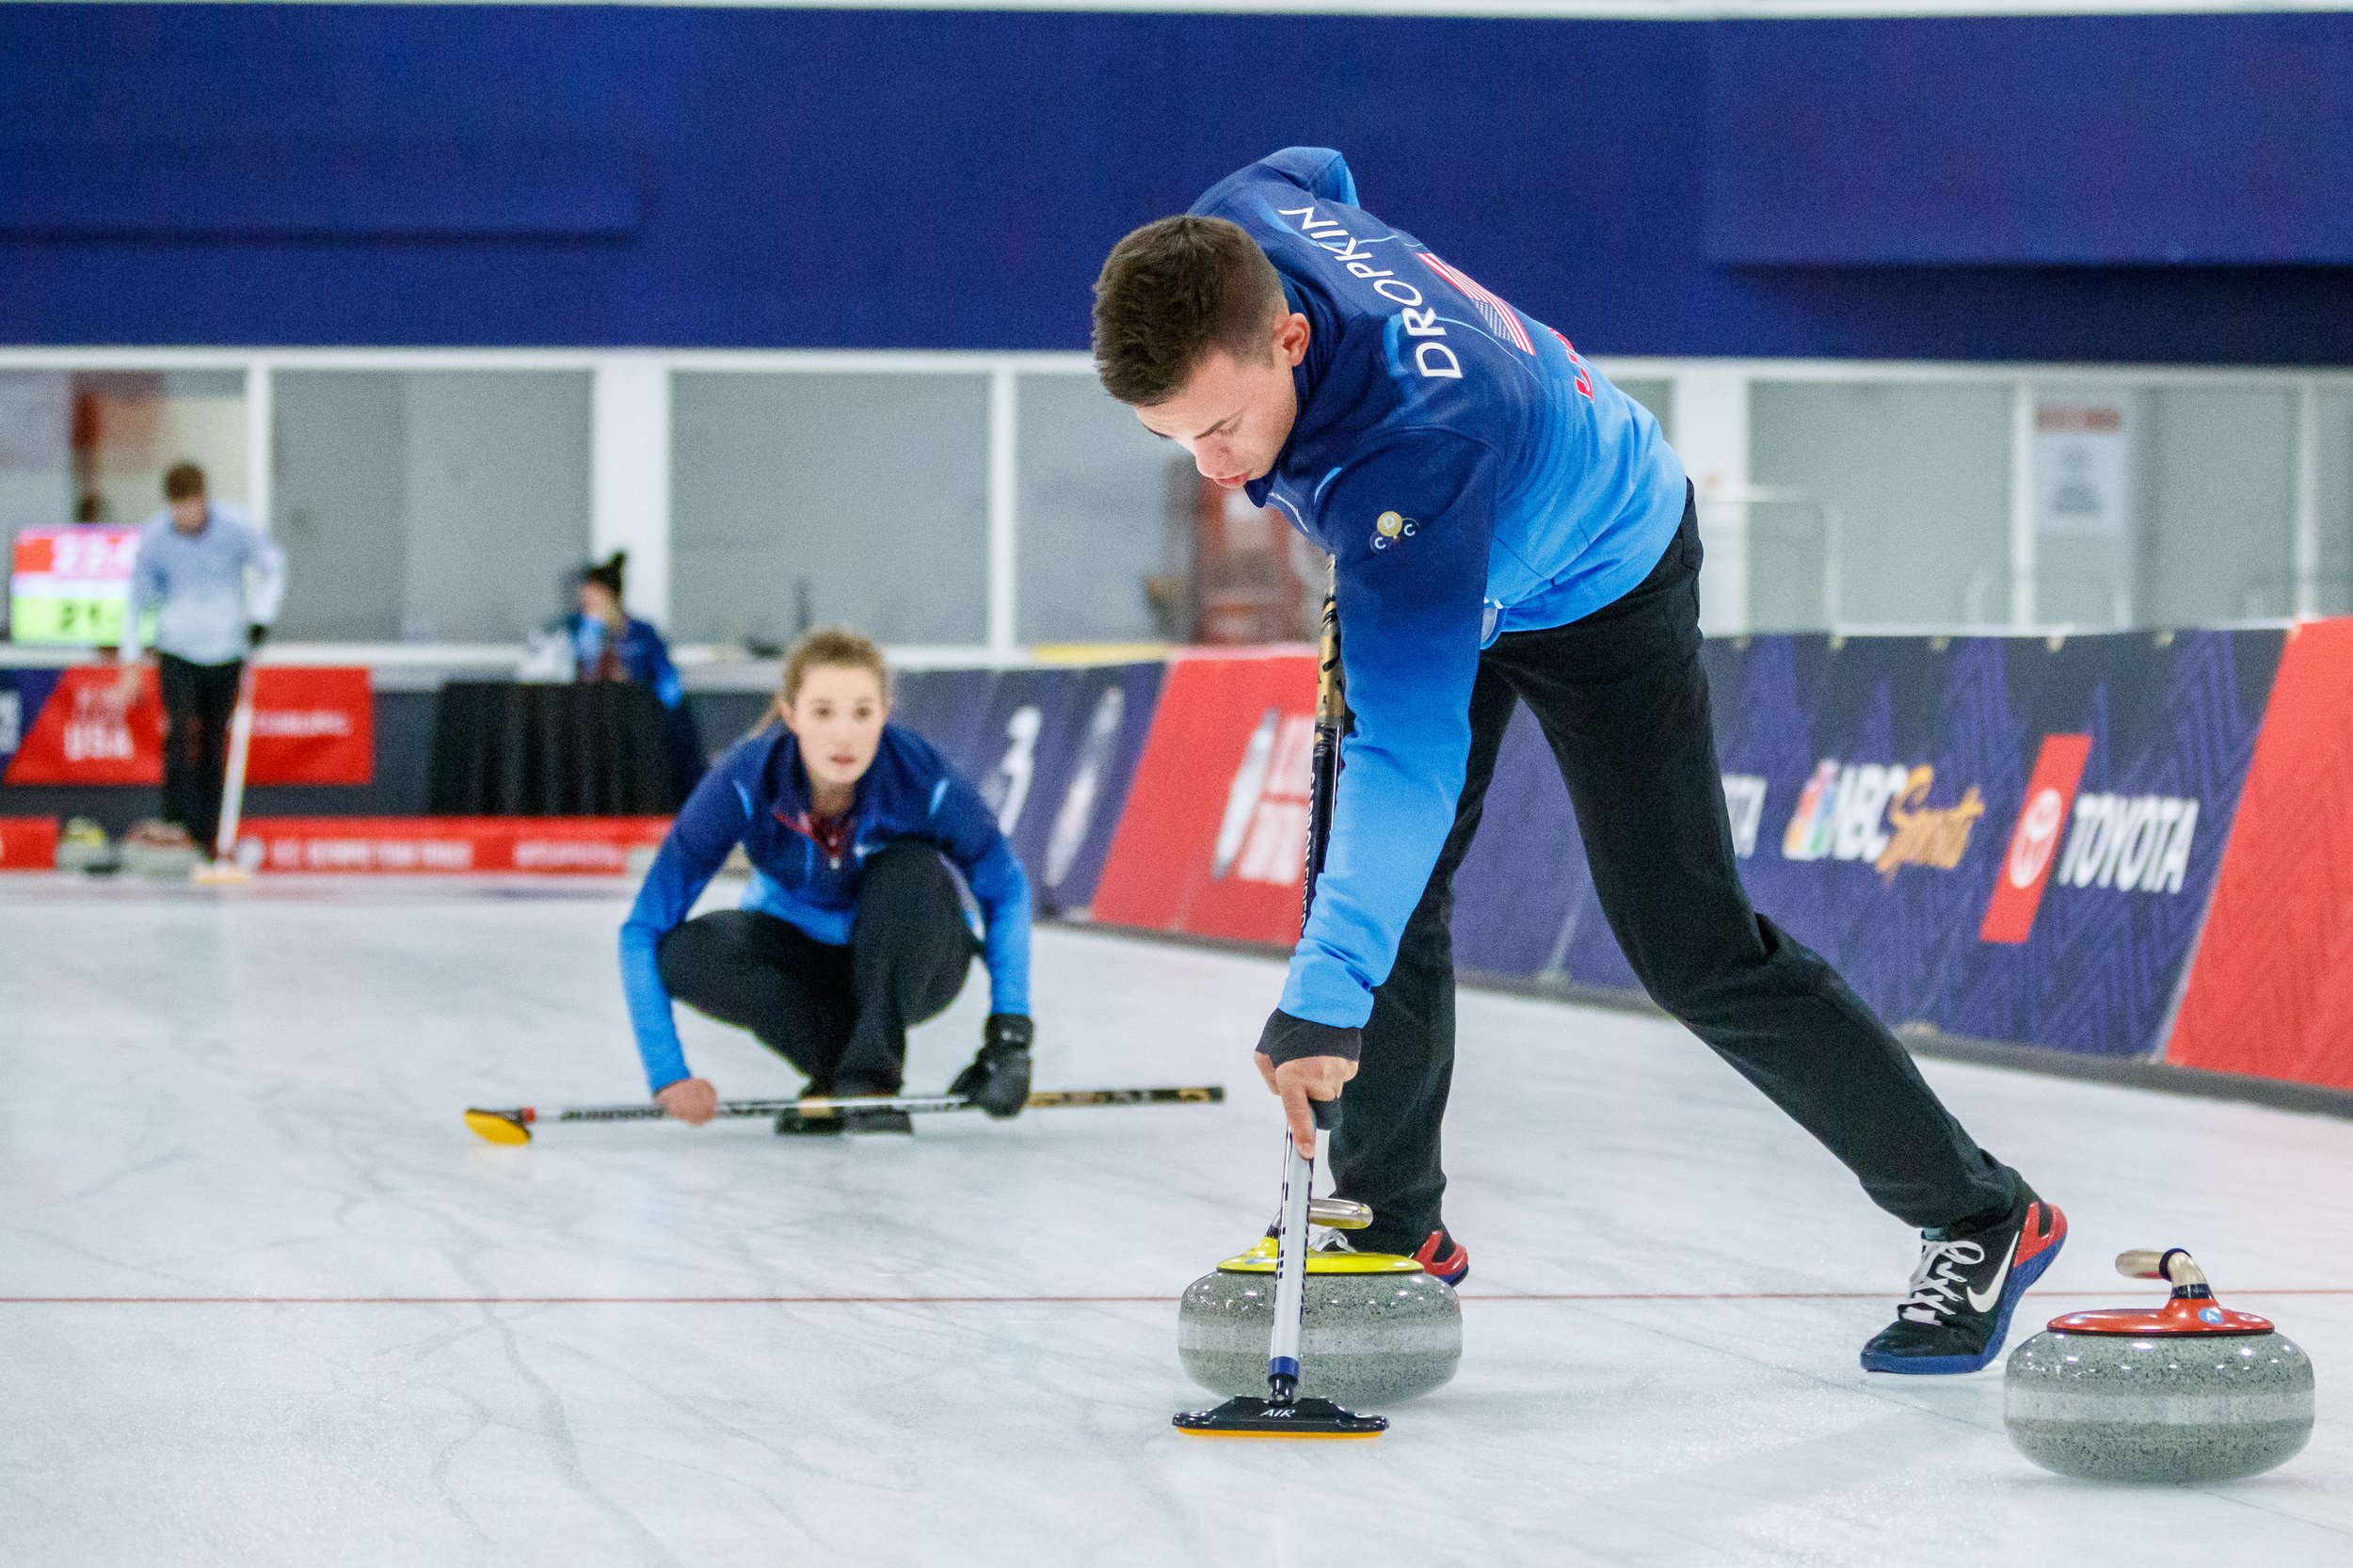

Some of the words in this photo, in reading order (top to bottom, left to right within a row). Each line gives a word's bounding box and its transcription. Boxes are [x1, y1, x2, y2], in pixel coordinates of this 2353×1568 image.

[1278, 206, 1464, 378] DROPKIN
[1831, 763, 1909, 863] NBC
[2059, 793, 2199, 892] TOYOTA
[1261, 1409, 1295, 1417] AIR
